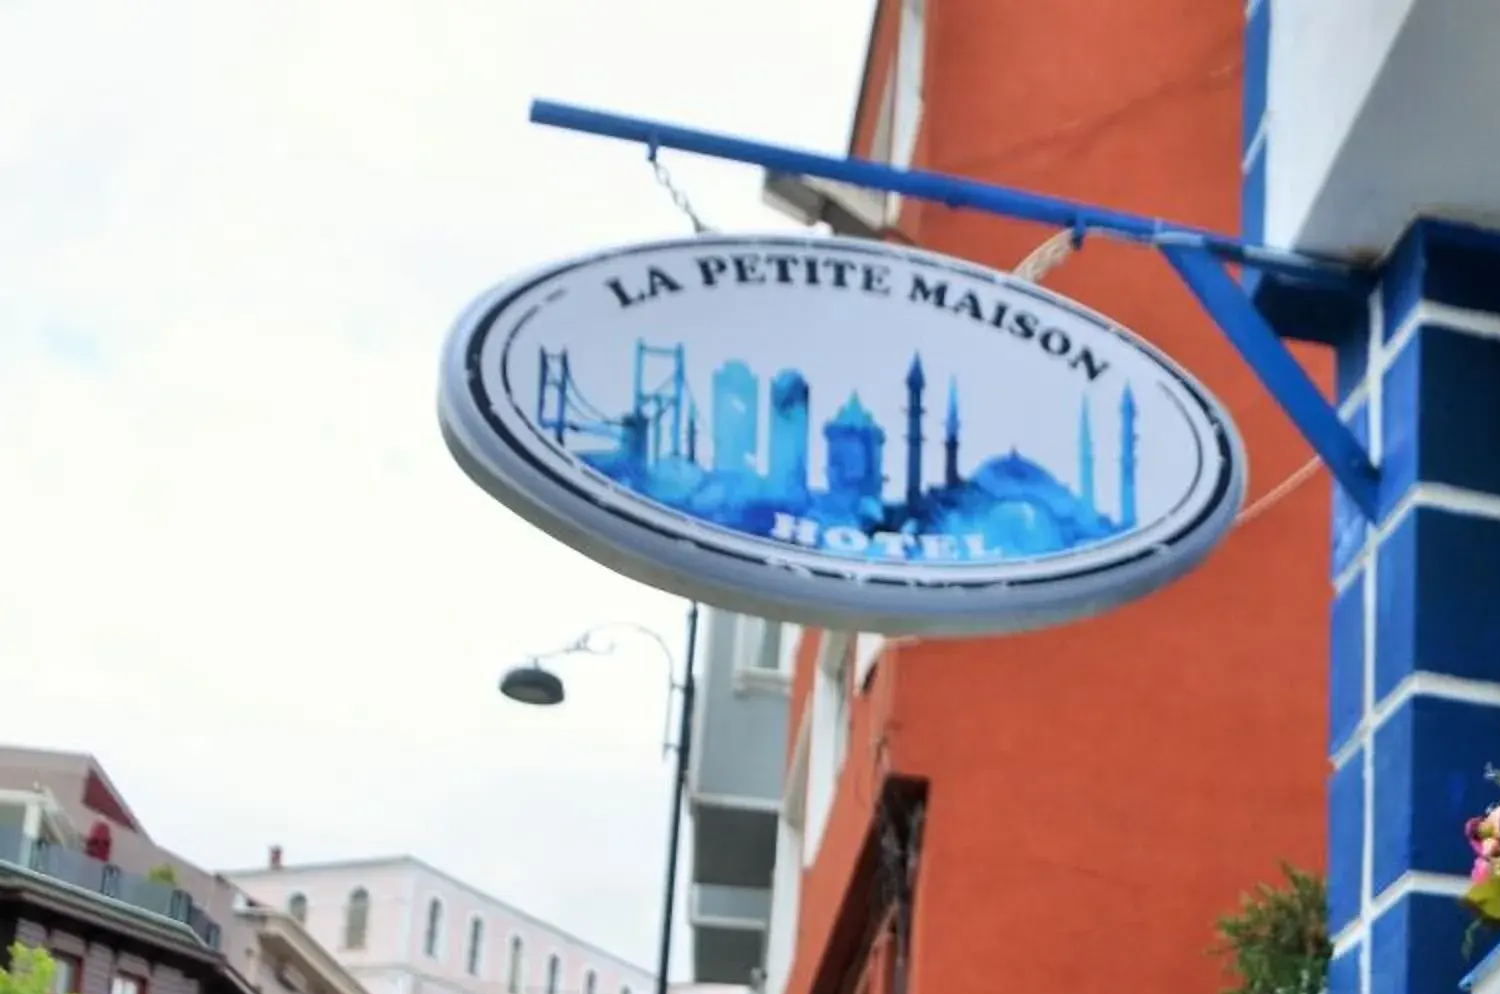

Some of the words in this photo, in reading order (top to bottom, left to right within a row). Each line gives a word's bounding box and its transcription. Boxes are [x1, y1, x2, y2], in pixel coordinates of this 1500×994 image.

[604, 264, 684, 309] LA
[695, 253, 892, 297] PETITE
[908, 275, 1109, 381] MAISON
[771, 511, 1004, 561] HOTEL
